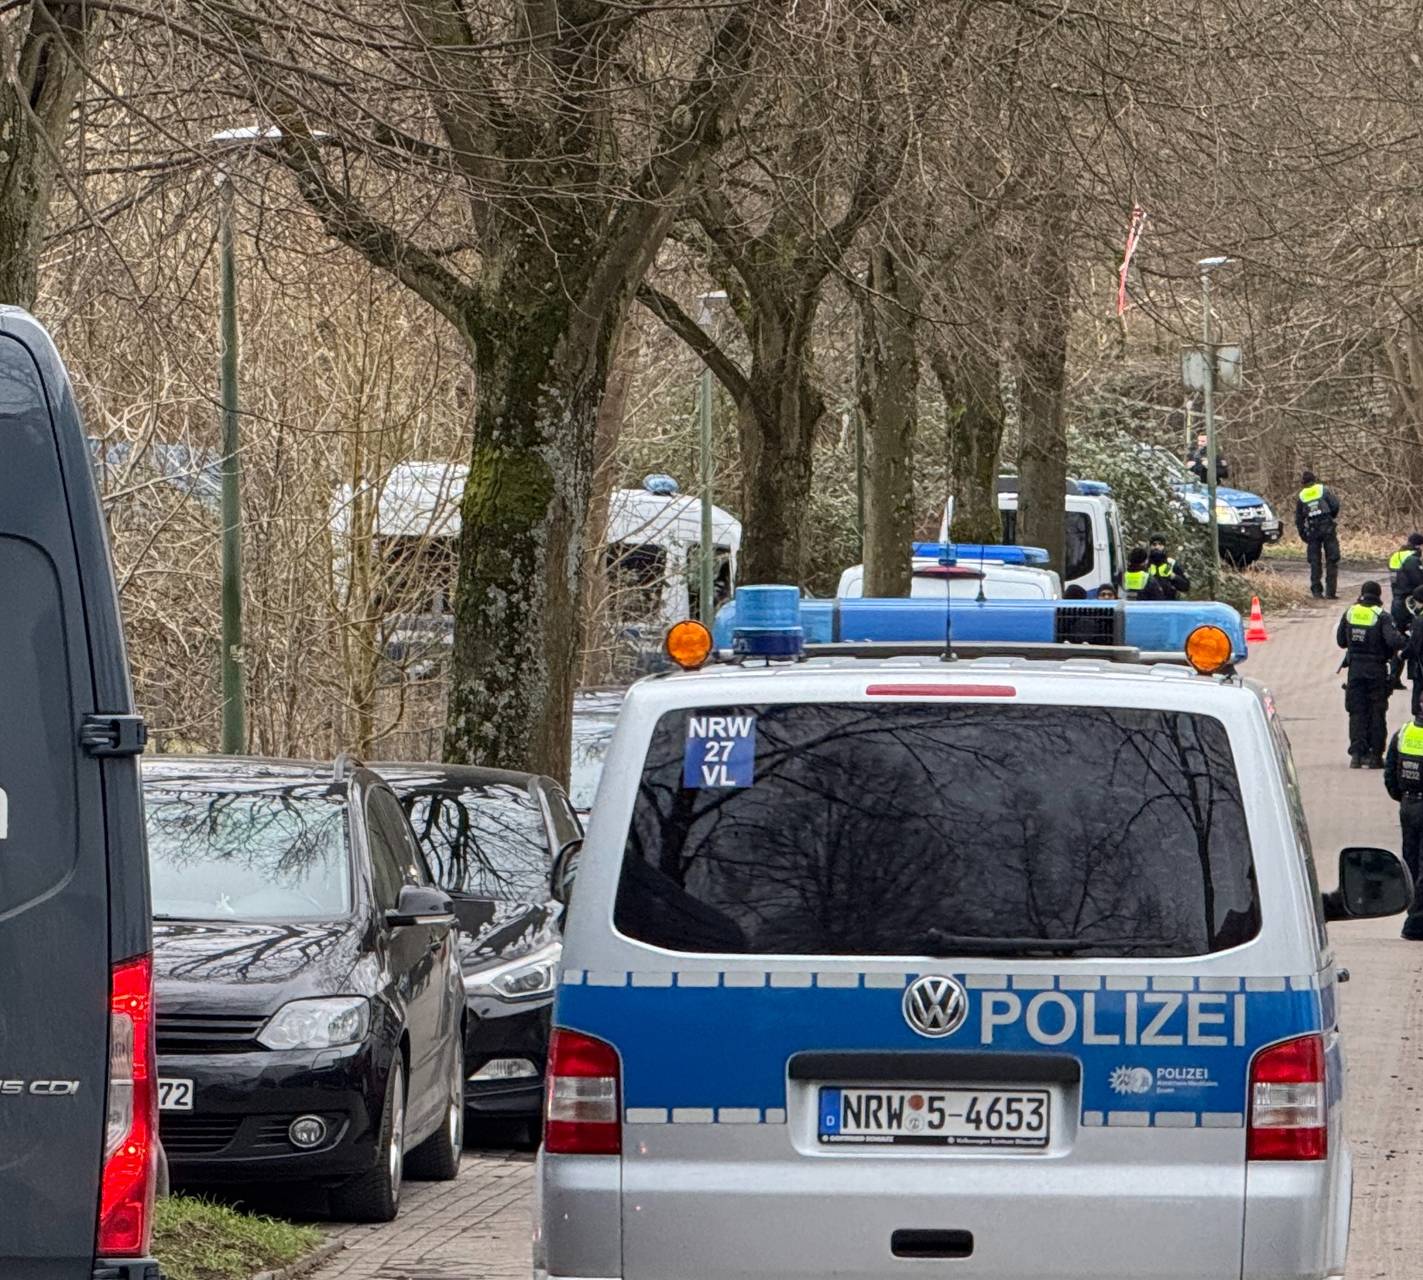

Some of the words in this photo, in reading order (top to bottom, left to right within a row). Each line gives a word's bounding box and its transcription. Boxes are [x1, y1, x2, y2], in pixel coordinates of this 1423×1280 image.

[688, 716, 753, 738] NRW
[703, 741, 735, 762] 27
[701, 765, 736, 787] VL
[908, 976, 964, 1033] VW
[980, 991, 1246, 1047] POLIZEI
[1156, 1067, 1208, 1079] POLIZEI
[29, 1080, 80, 1095] CDI
[159, 1082, 190, 1106] 72
[826, 1115, 835, 1127] D
[842, 1094, 905, 1130] NRW
[927, 1096, 1045, 1132] 5-4653
